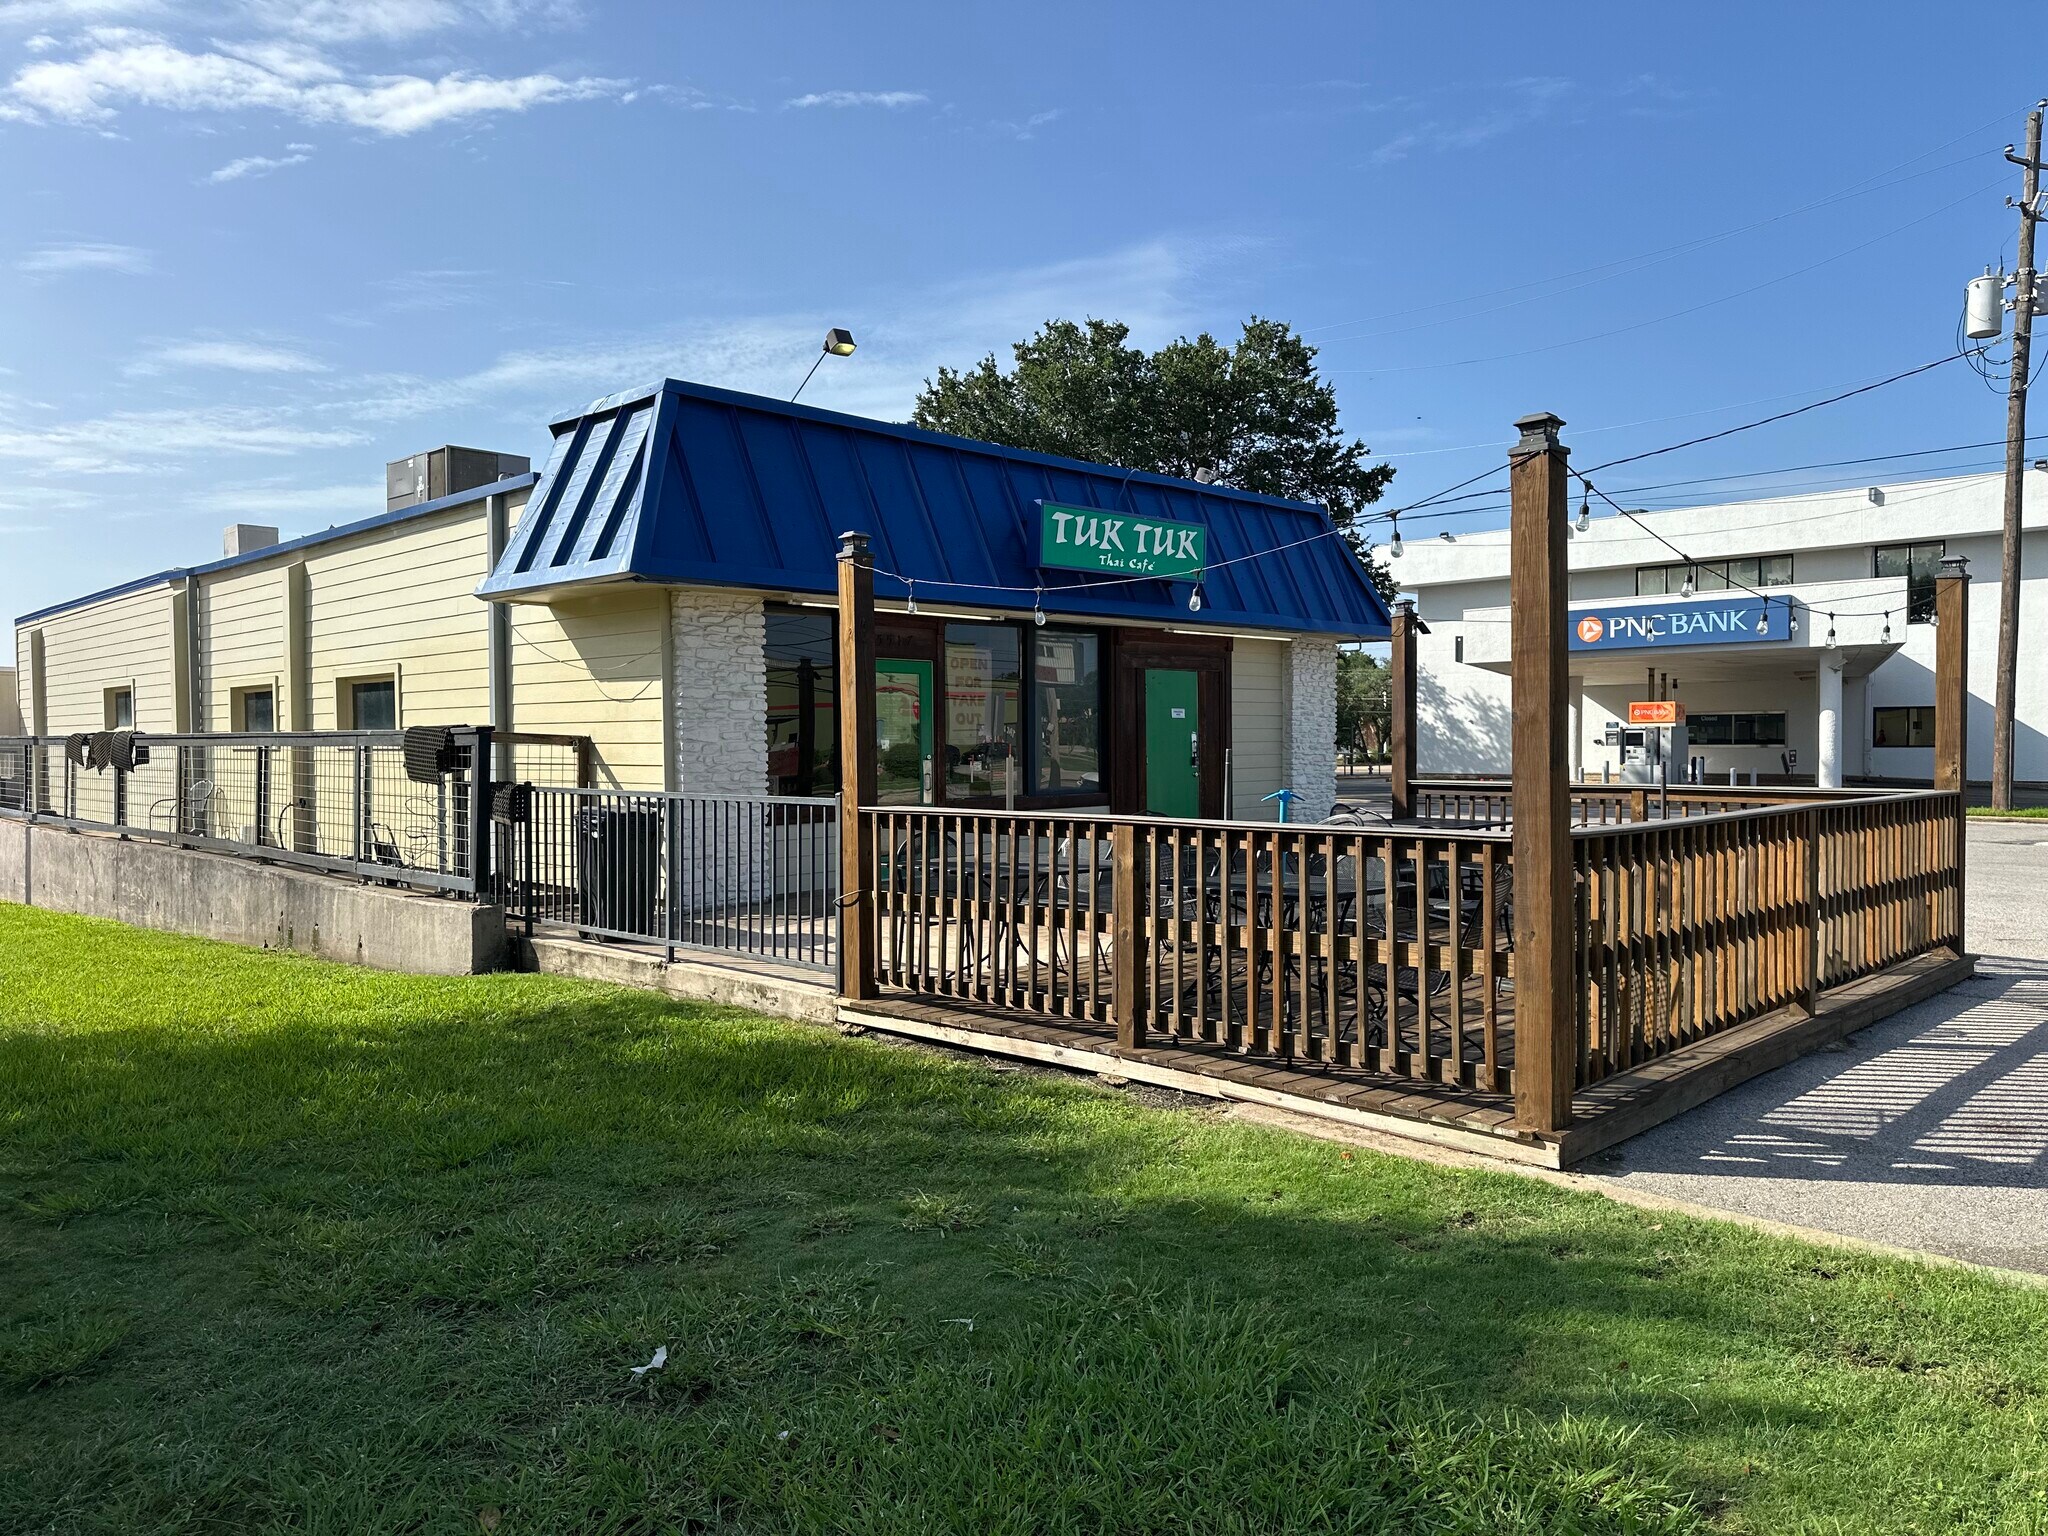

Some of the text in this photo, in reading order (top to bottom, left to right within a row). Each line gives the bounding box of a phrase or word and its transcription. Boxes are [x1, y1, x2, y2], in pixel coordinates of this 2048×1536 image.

[1051, 511, 1198, 561] TUK TUK
[1098, 553, 1156, 573] Thai Café
[1607, 608, 1749, 639] PNC BANK
[950, 657, 988, 670] OPEN
[955, 675, 982, 688] FOR
[951, 694, 986, 707] TAKE
[955, 712, 982, 725] OUT
